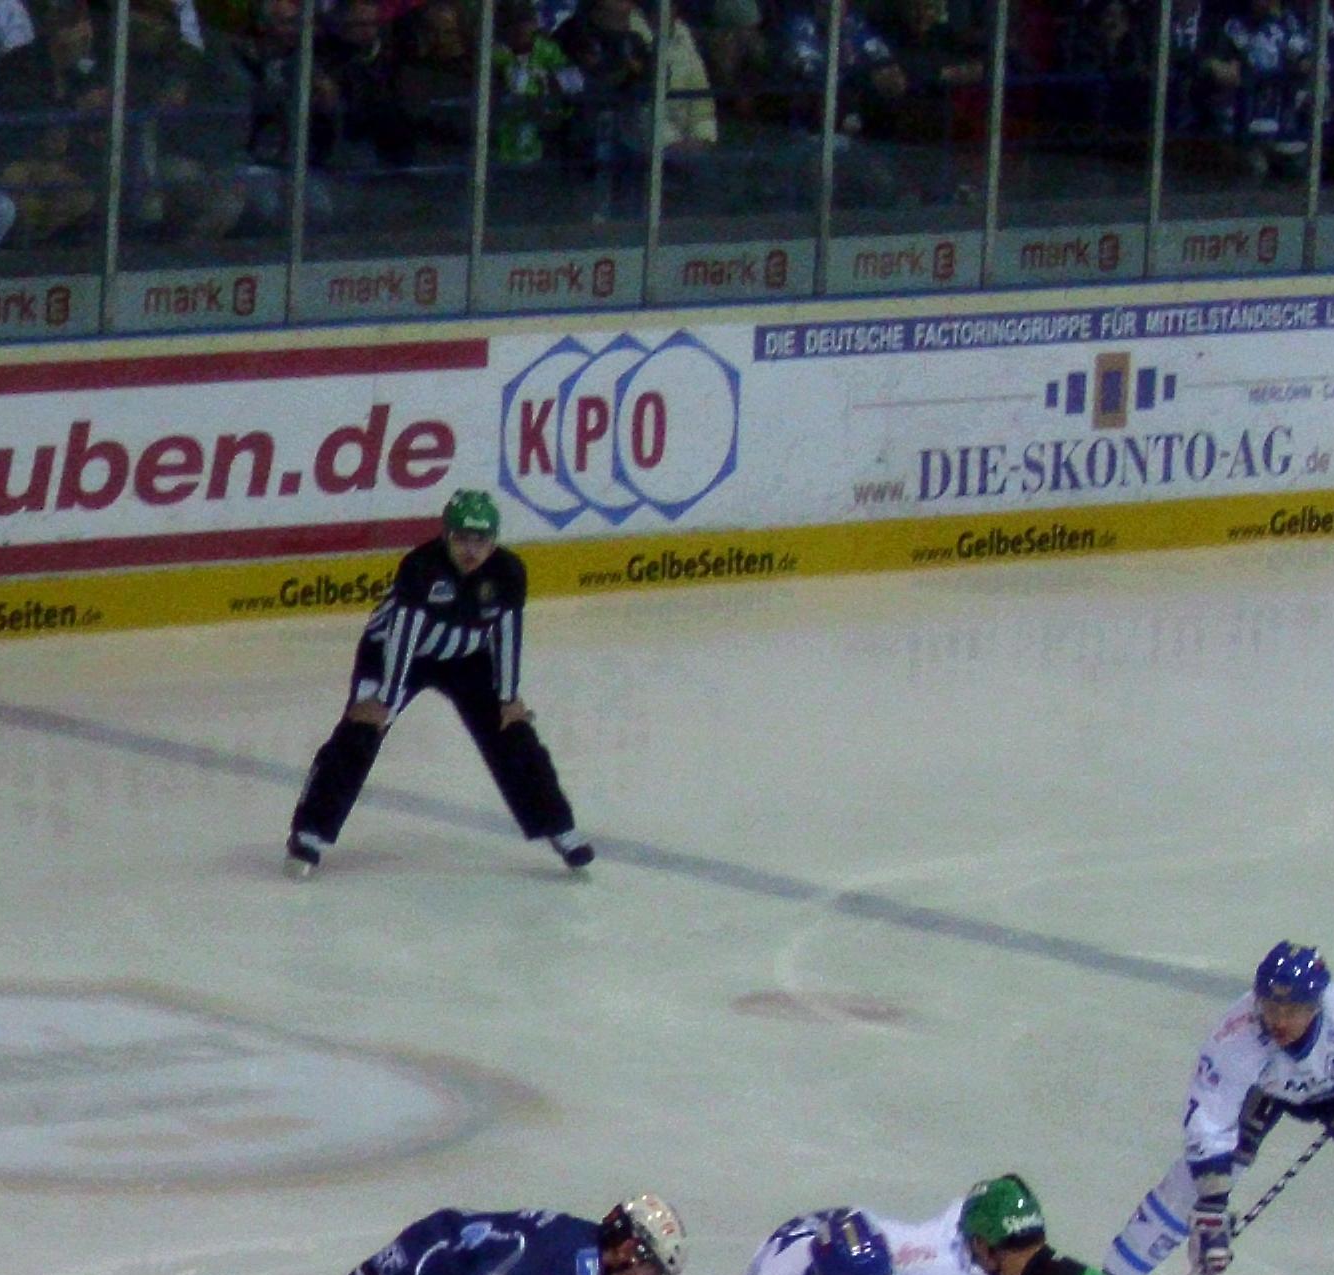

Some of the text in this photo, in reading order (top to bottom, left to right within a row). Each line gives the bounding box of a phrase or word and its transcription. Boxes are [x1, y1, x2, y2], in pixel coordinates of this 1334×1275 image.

[853, 245, 925, 280] mark
[1020, 238, 1089, 268] mark
[1182, 231, 1249, 262] mark
[508, 262, 582, 294] mark
[683, 251, 755, 286] mark
[144, 280, 223, 314] mark
[327, 270, 403, 304] mark
[765, 331, 796, 355] DIE
[805, 325, 905, 353] DEUTSCHE
[913, 314, 1092, 348] FACTORINGGRUPPE
[1100, 307, 1137, 338] FÜR
[518, 390, 667, 479] KPO
